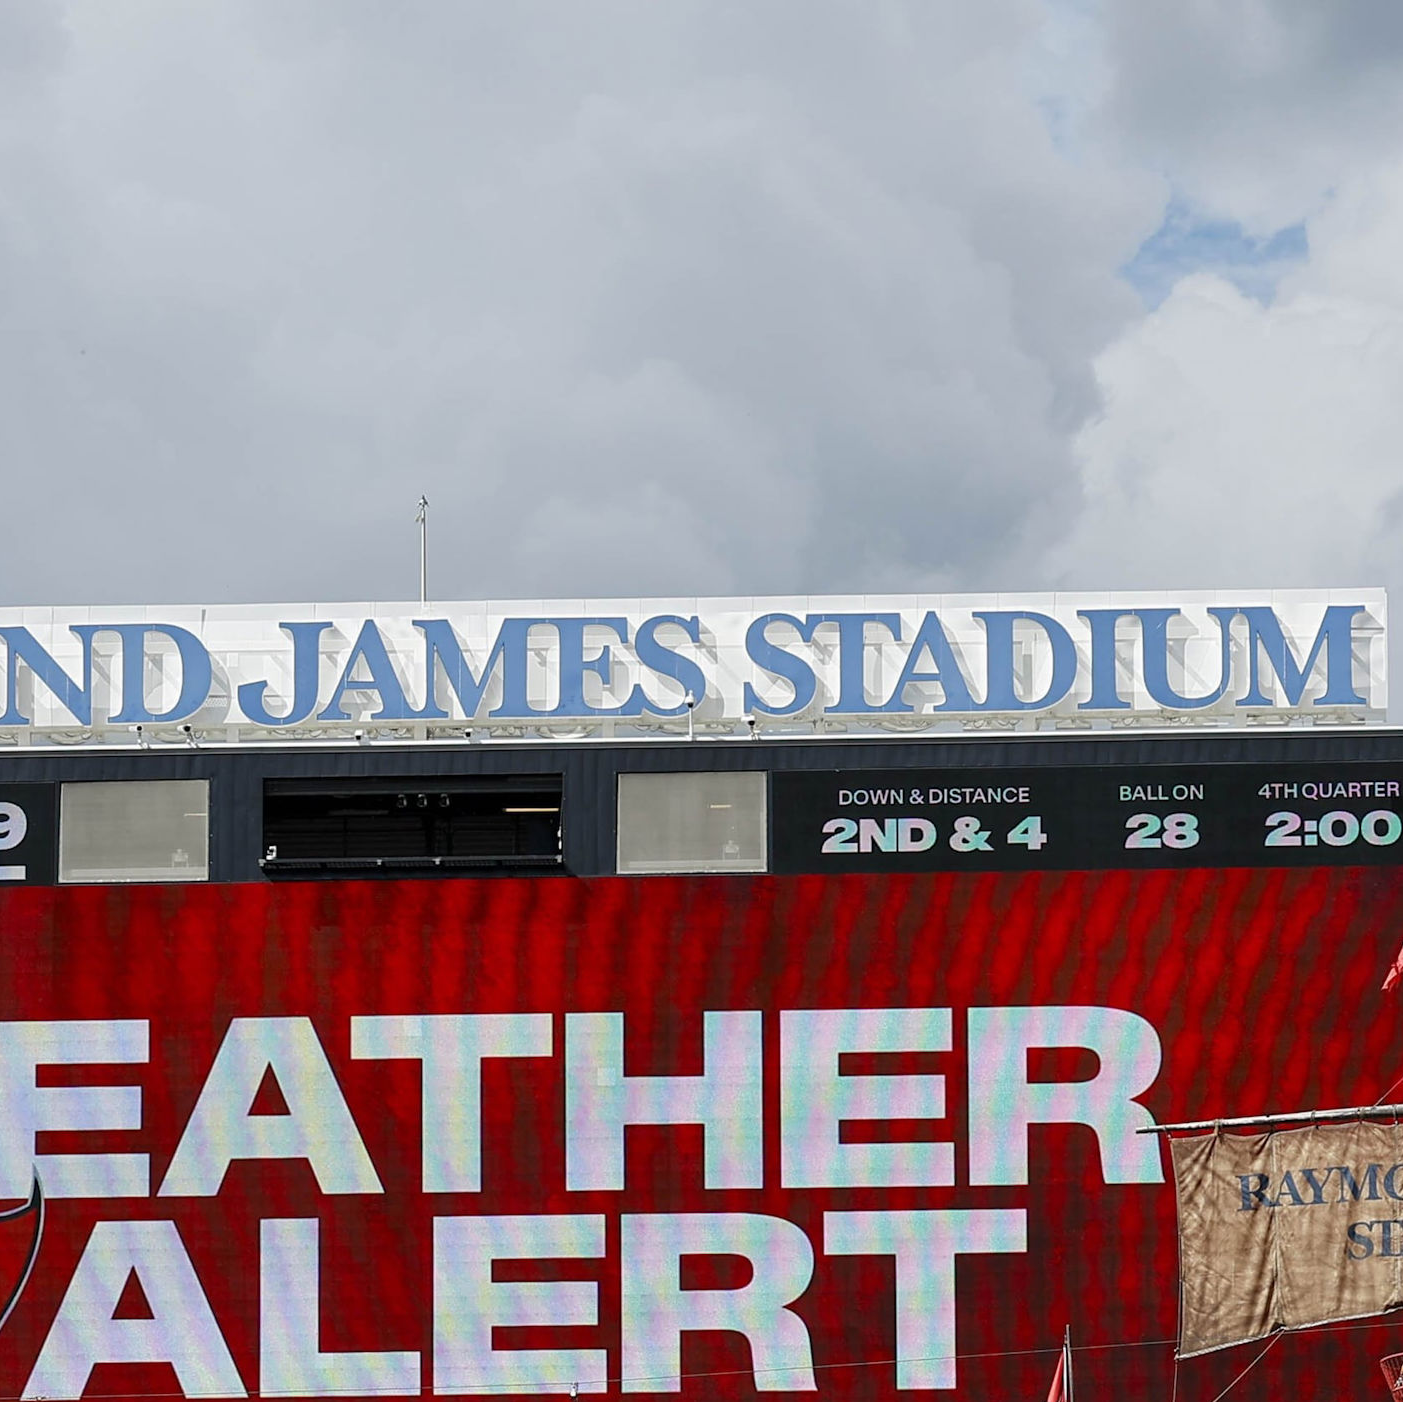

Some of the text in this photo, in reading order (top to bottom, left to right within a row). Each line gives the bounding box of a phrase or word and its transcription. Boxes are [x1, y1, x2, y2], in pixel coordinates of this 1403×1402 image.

[237, 615, 707, 726] JAMES
[744, 604, 1367, 716] STADIUM
[838, 786, 1030, 805] DOWN & DISTANCE
[1119, 784, 1204, 802] BALL ON
[1258, 781, 1400, 800] 4TH QUARTER
[821, 813, 1047, 856] 2ND & 4
[1125, 812, 1200, 850] 28
[1263, 811, 1402, 848] 2:00
[19, 1208, 1028, 1401] ALERT
